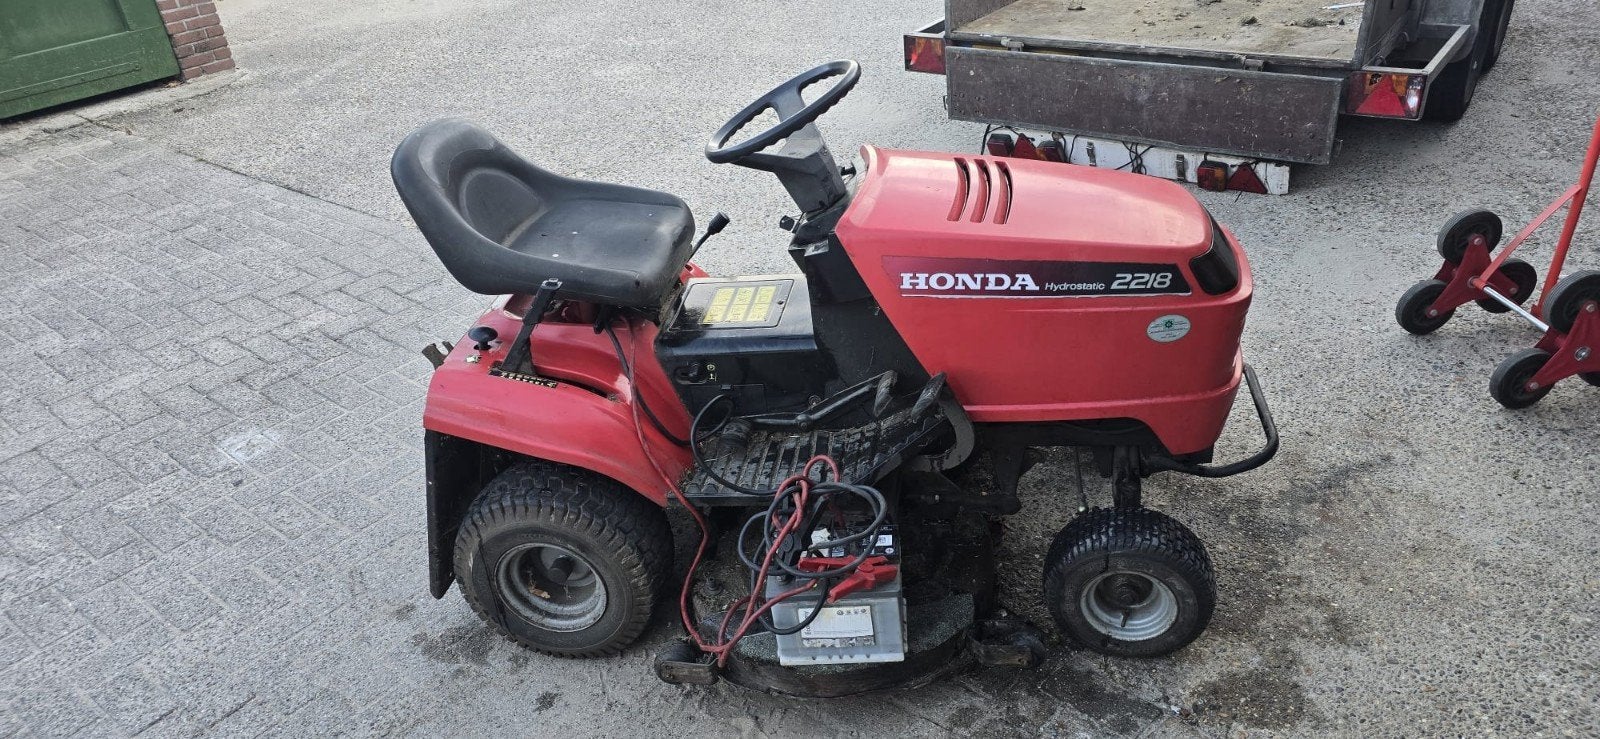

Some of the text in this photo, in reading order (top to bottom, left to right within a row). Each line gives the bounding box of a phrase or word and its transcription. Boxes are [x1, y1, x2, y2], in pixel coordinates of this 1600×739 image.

[900, 272, 1173, 292] HONDA Hydrostatic 2218
